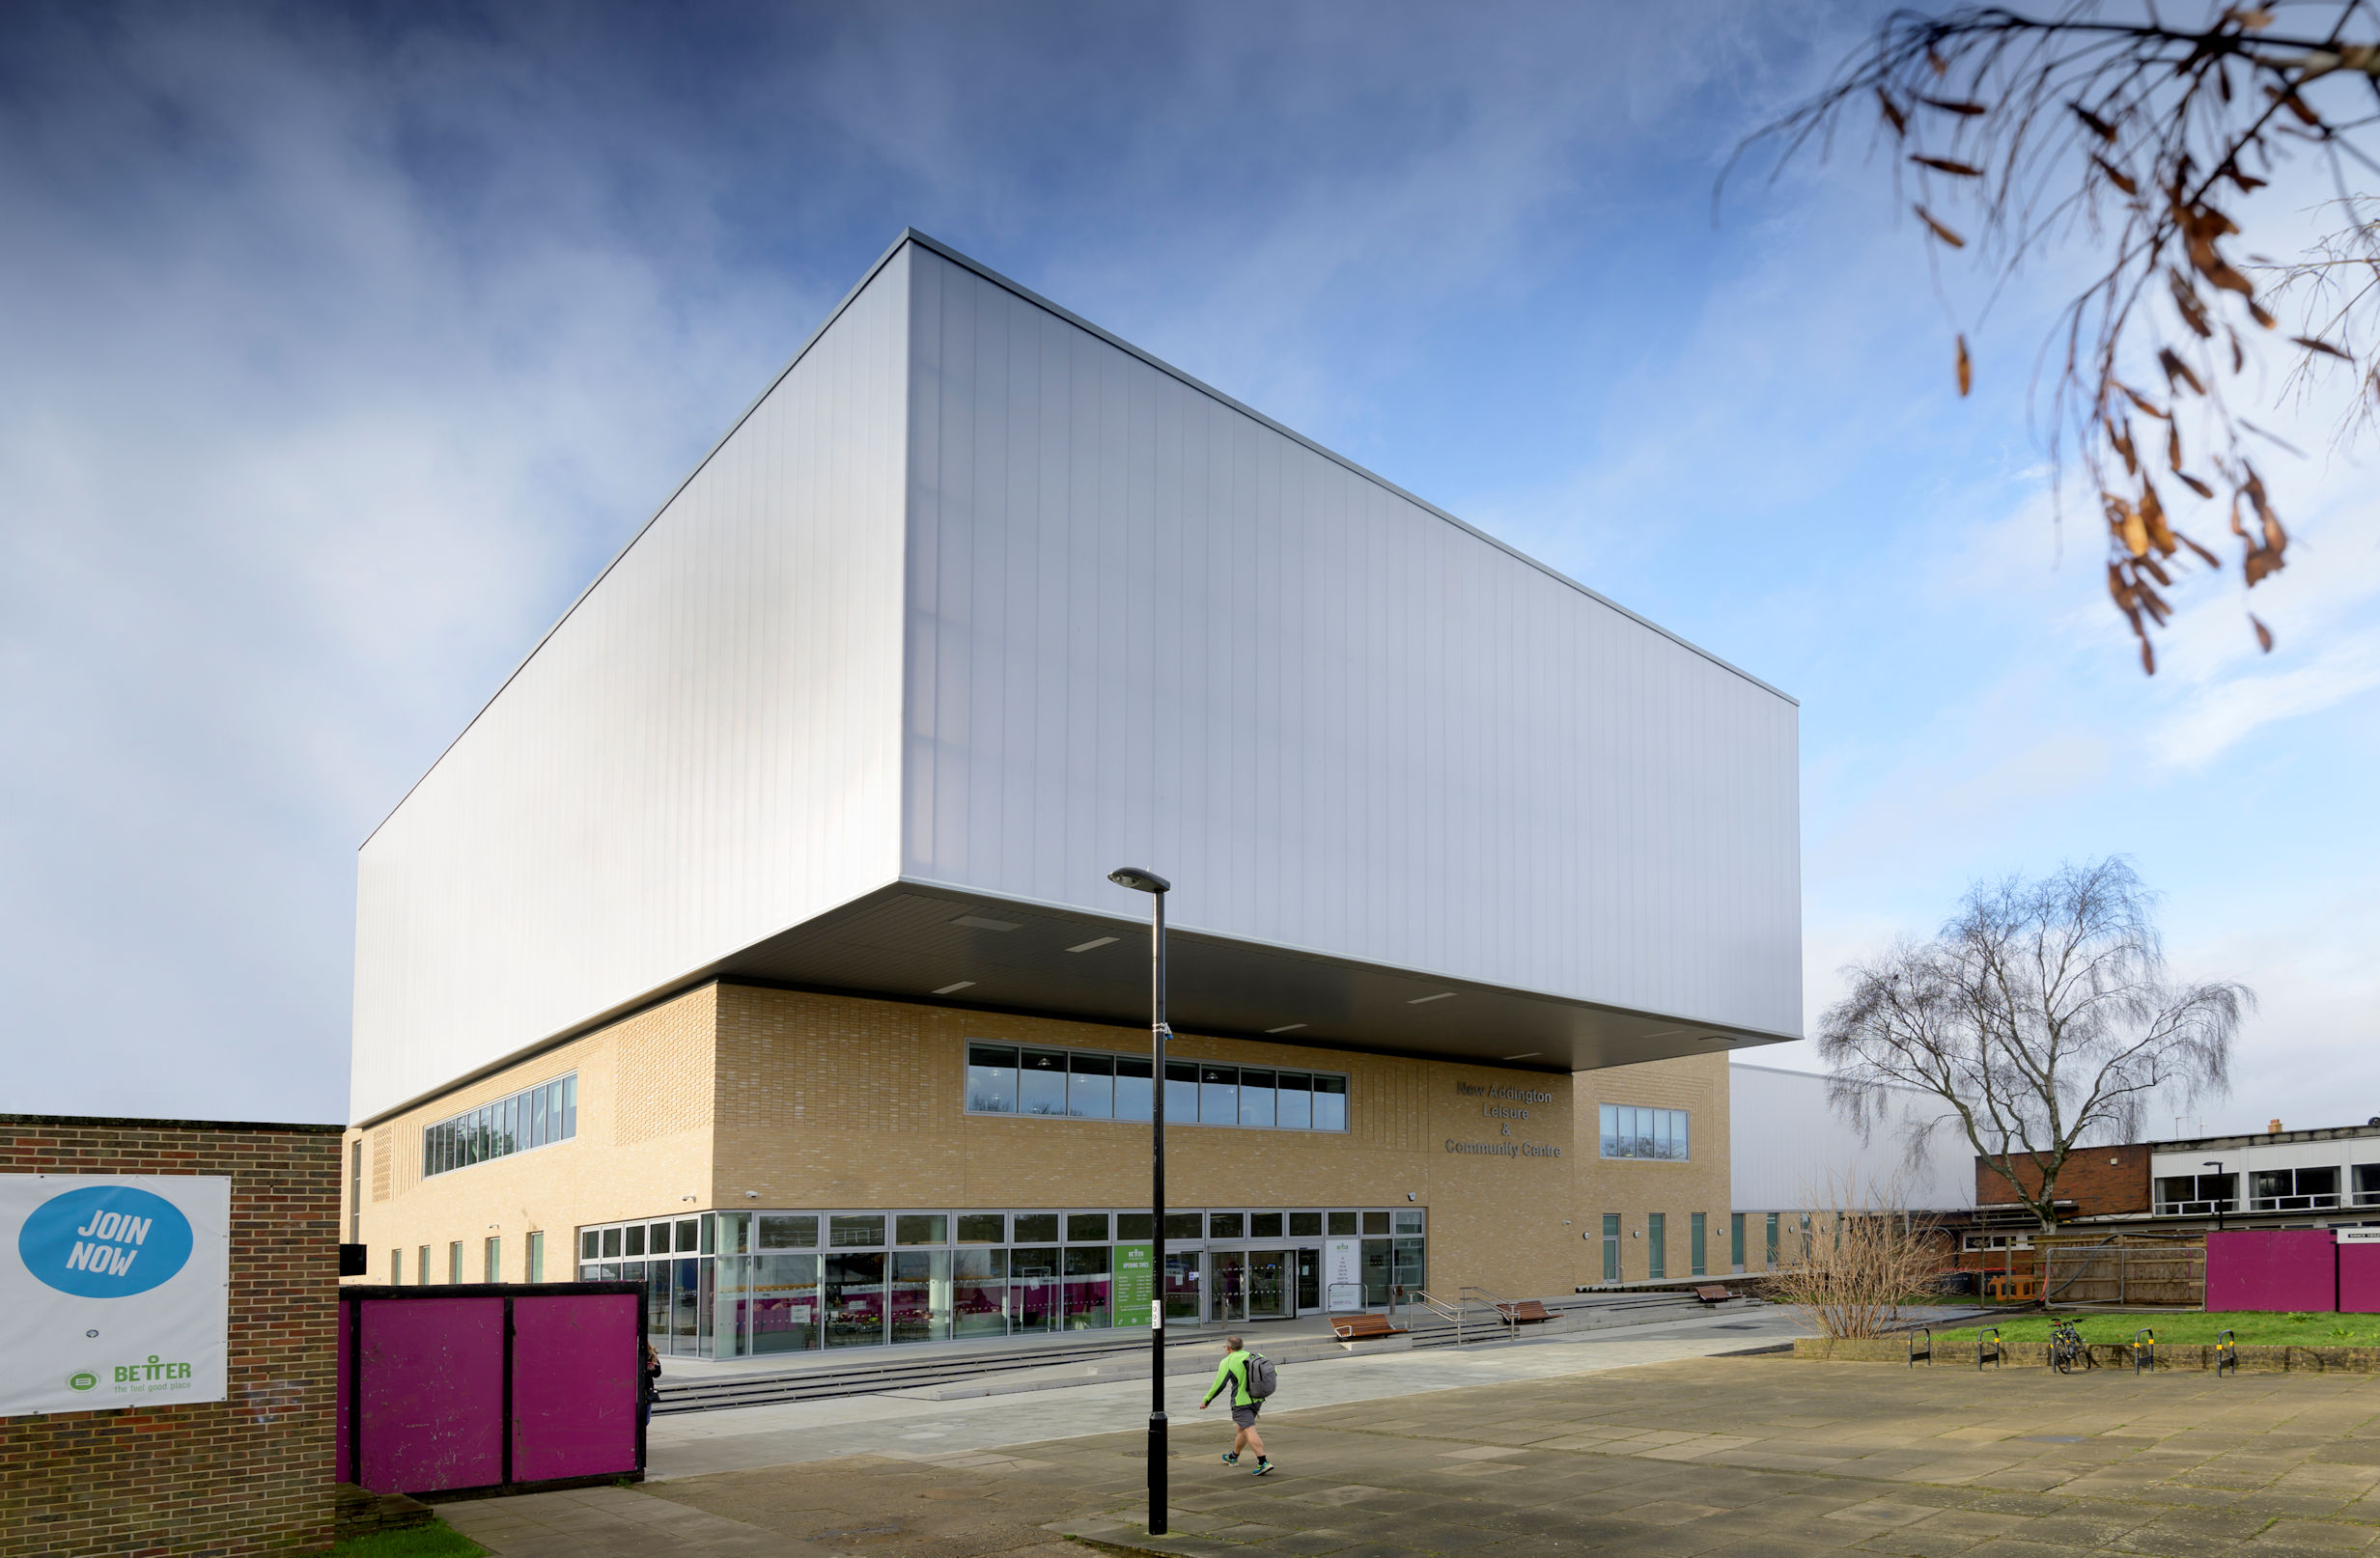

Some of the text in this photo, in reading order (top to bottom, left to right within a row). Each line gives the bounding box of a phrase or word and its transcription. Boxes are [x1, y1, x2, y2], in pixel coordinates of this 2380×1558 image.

[1456, 1081, 1552, 1104] New Addington
[1483, 1103, 1529, 1120] Leisure
[1500, 1122, 1511, 1136] &
[1445, 1138, 1562, 1158] Community Centre
[77, 1210, 153, 1245] JOIN
[66, 1240, 138, 1277] NOW
[114, 1358, 191, 1382] BETTER
[148, 1383, 167, 1393] good
[170, 1382, 191, 1391] place
